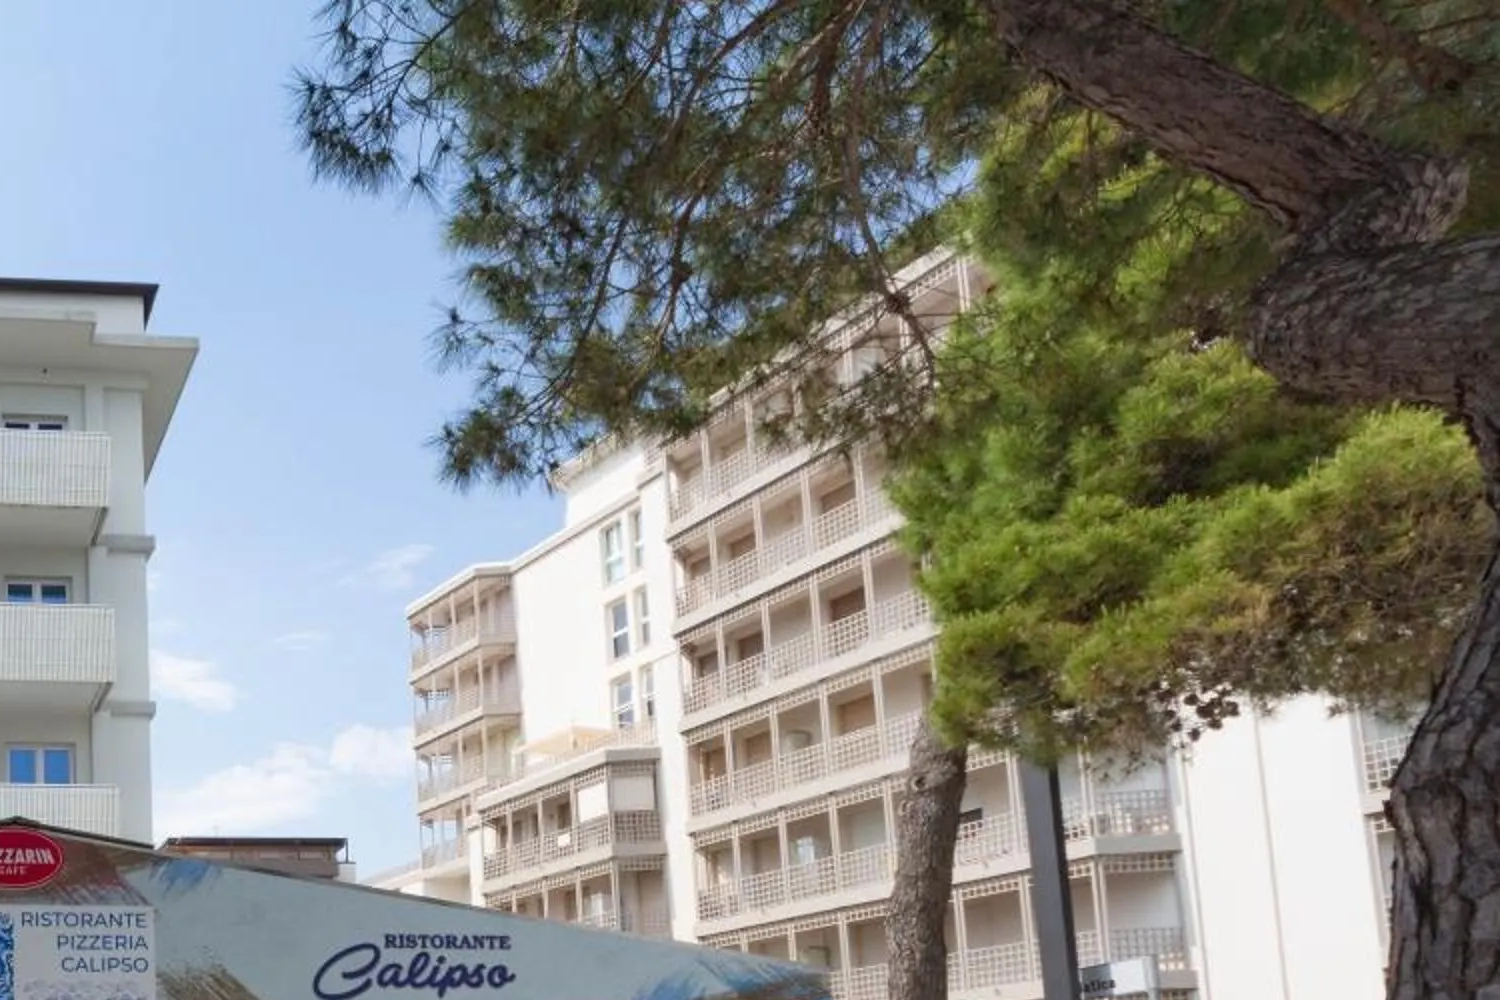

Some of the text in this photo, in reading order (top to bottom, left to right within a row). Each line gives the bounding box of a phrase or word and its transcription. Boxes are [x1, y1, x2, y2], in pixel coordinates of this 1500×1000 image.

[21, 911, 147, 928] RISTORANTE
[57, 935, 148, 950] PIZZERIA
[383, 933, 511, 950] RISTORANTE
[61, 956, 149, 973] CALIPSO
